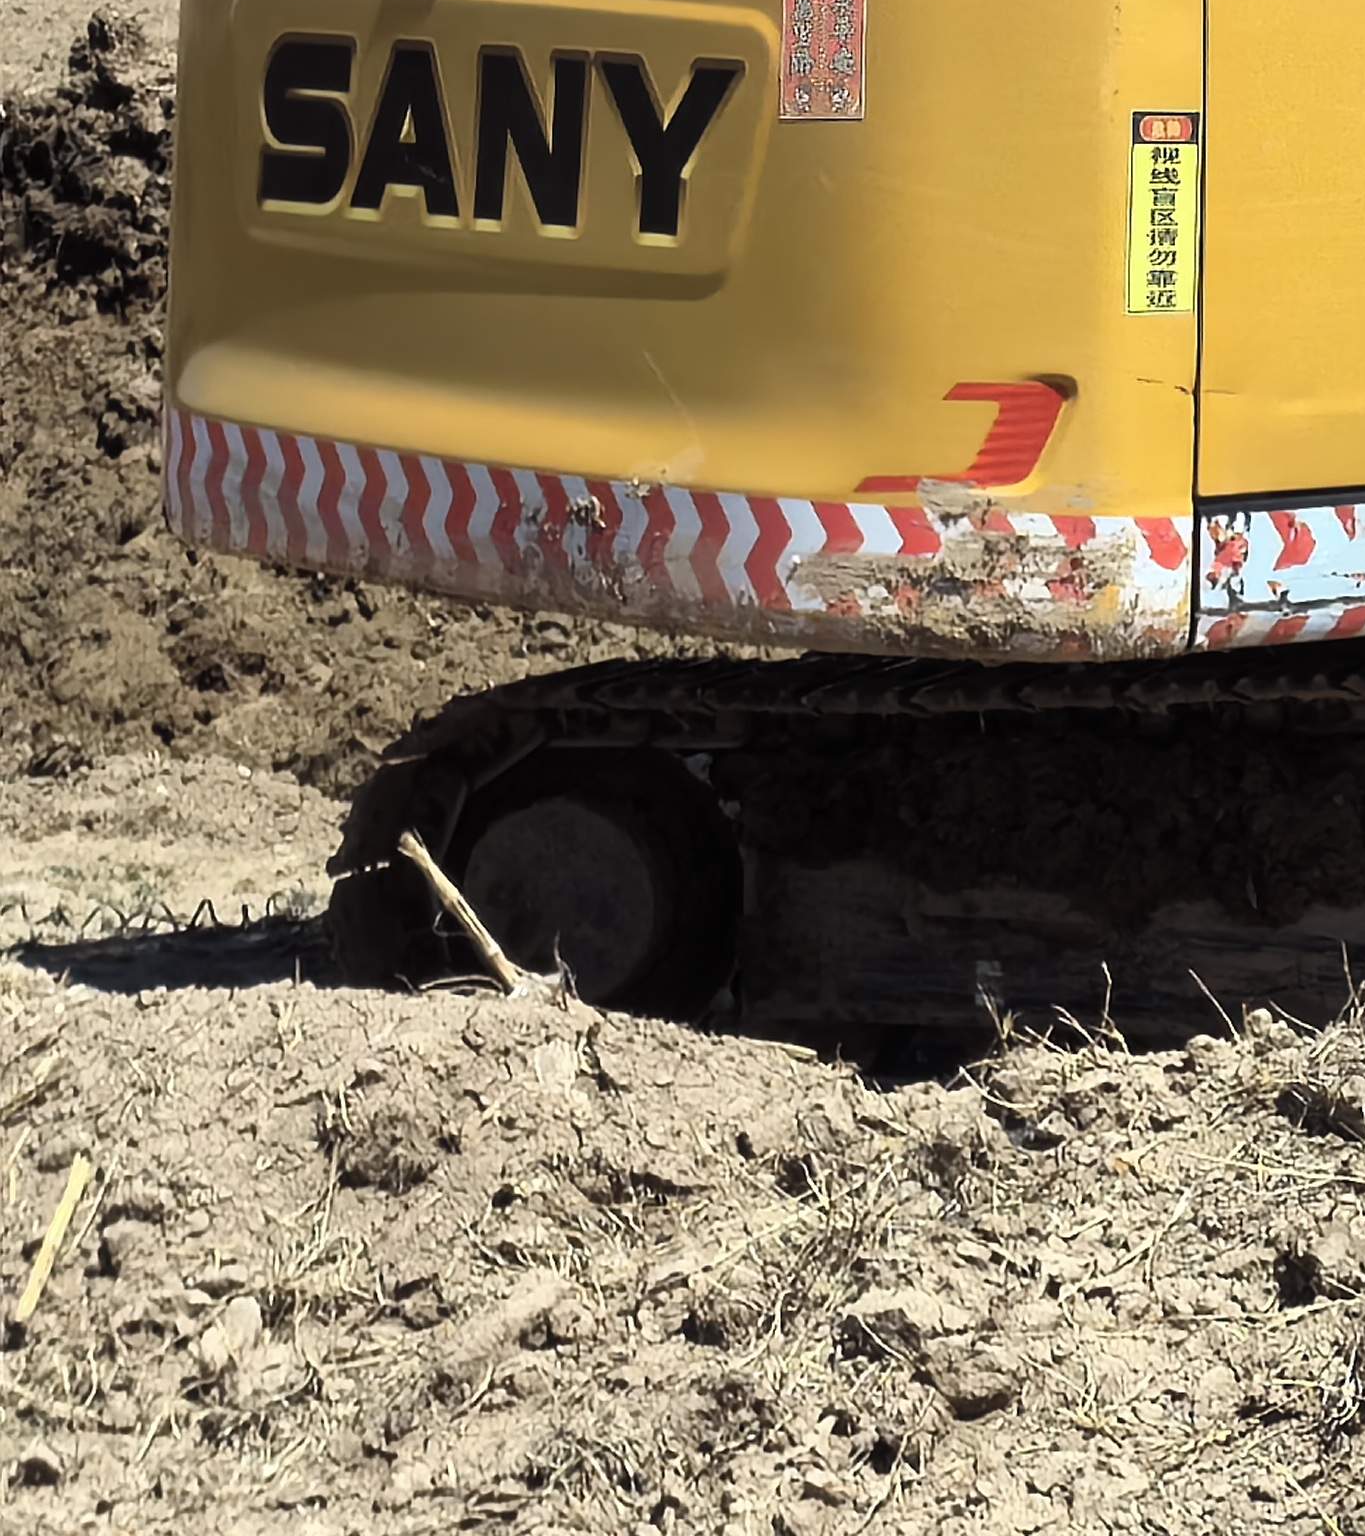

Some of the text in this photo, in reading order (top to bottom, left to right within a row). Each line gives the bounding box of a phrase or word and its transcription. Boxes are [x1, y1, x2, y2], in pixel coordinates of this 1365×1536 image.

[257, 32, 747, 247] SANY
[1146, 146, 1182, 308] 视线盲区请勿靠近
